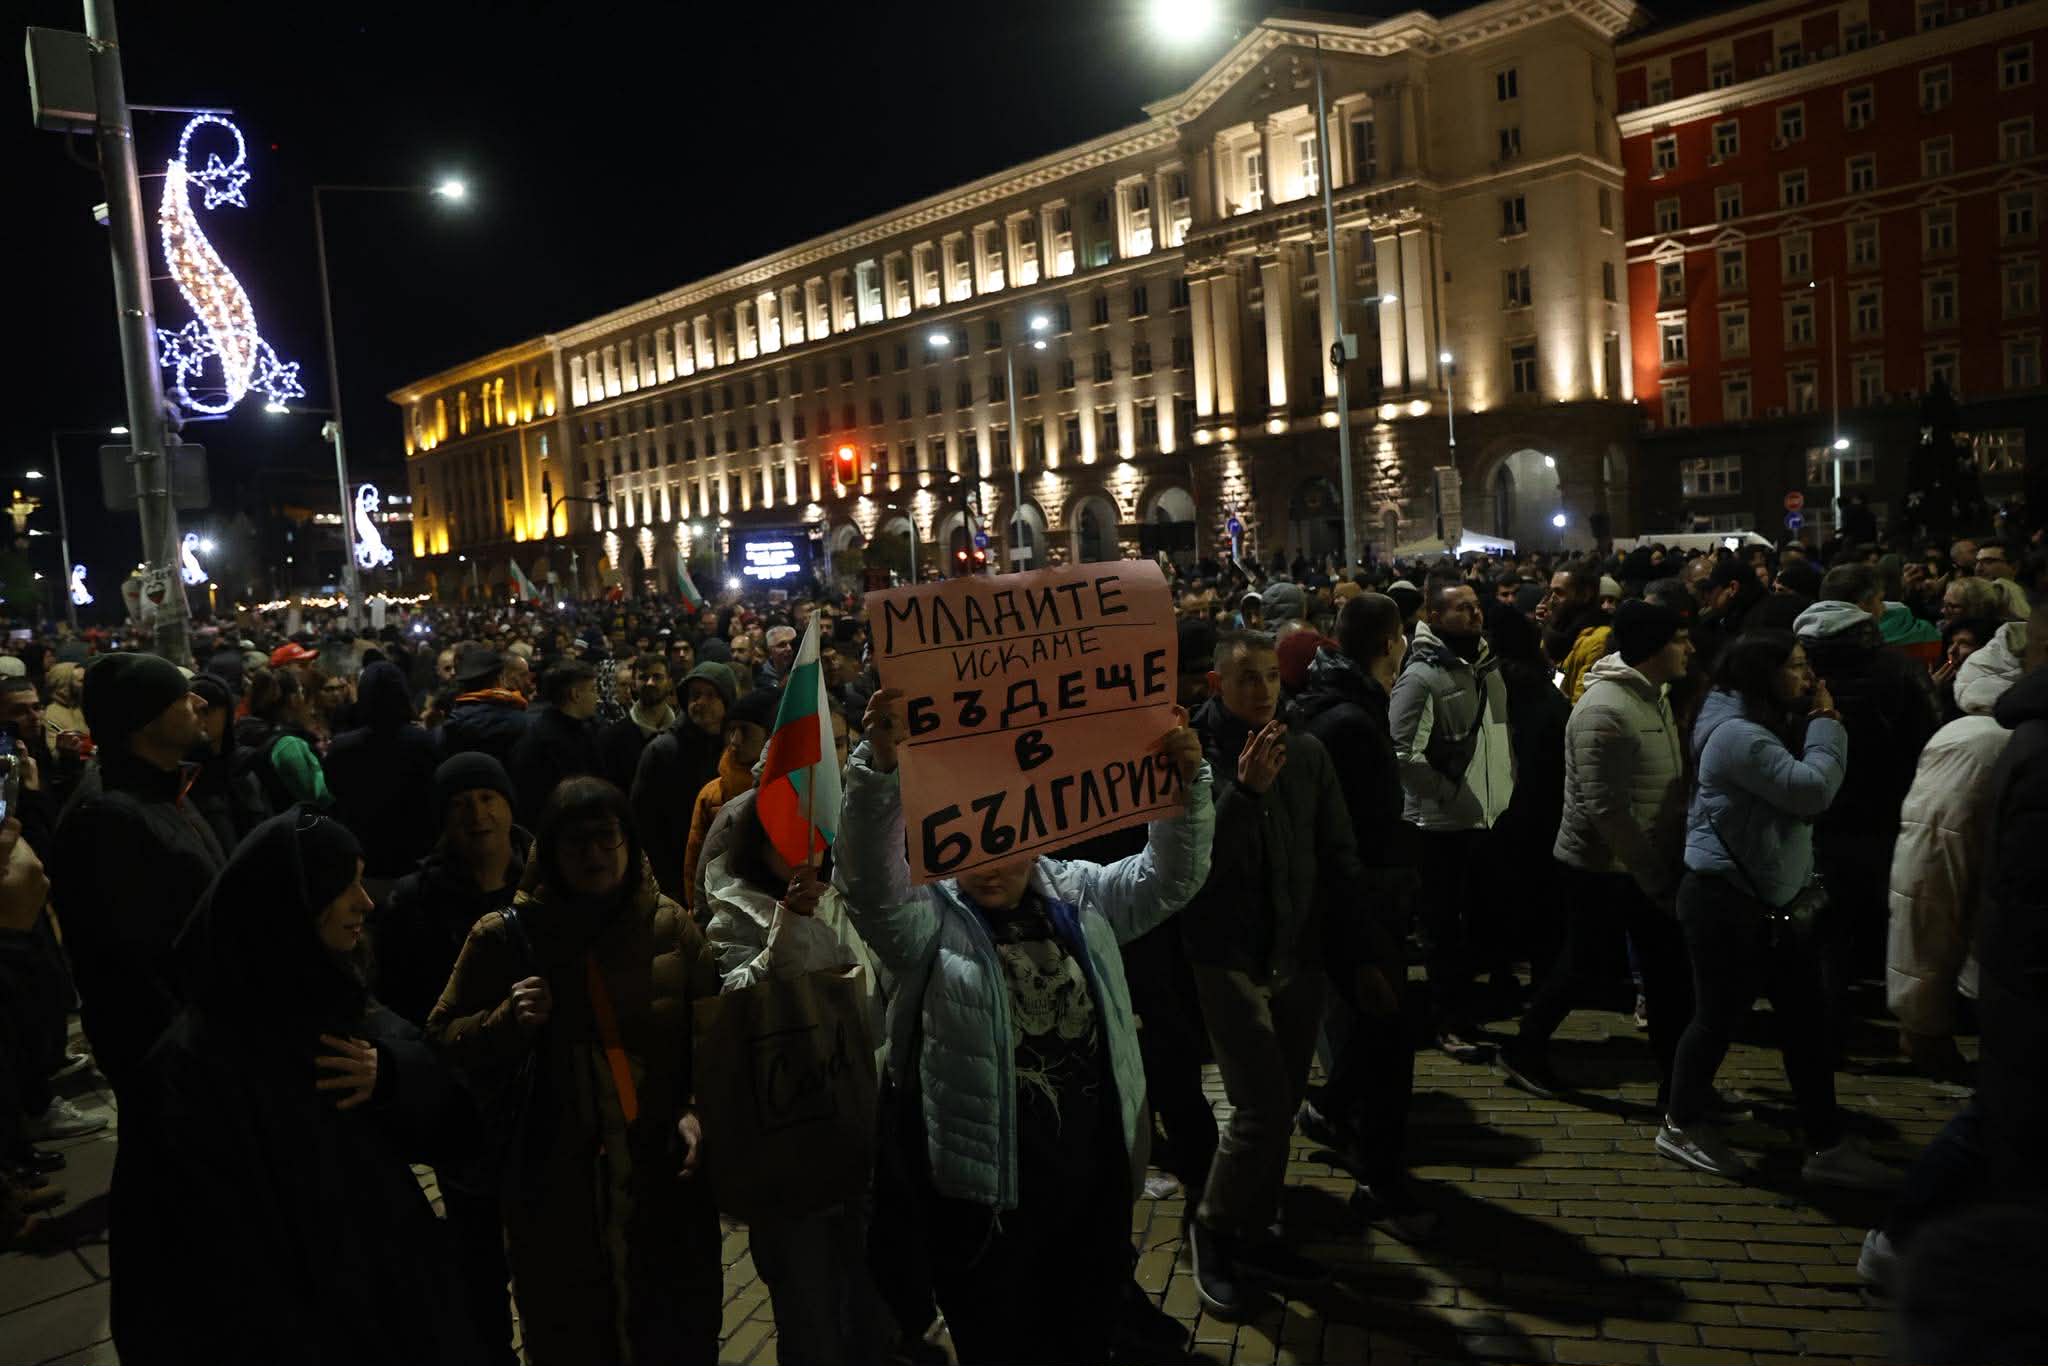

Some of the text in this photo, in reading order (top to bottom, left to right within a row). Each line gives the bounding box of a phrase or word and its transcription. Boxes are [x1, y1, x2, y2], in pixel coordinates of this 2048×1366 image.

[884, 575, 1128, 654] МЛАДИТЕ
[953, 628, 1100, 681] ИСКАМЕ
[907, 650, 1166, 736] БЪДЕЩЕ
[921, 752, 1184, 874] БЪЛГАРИЯ
